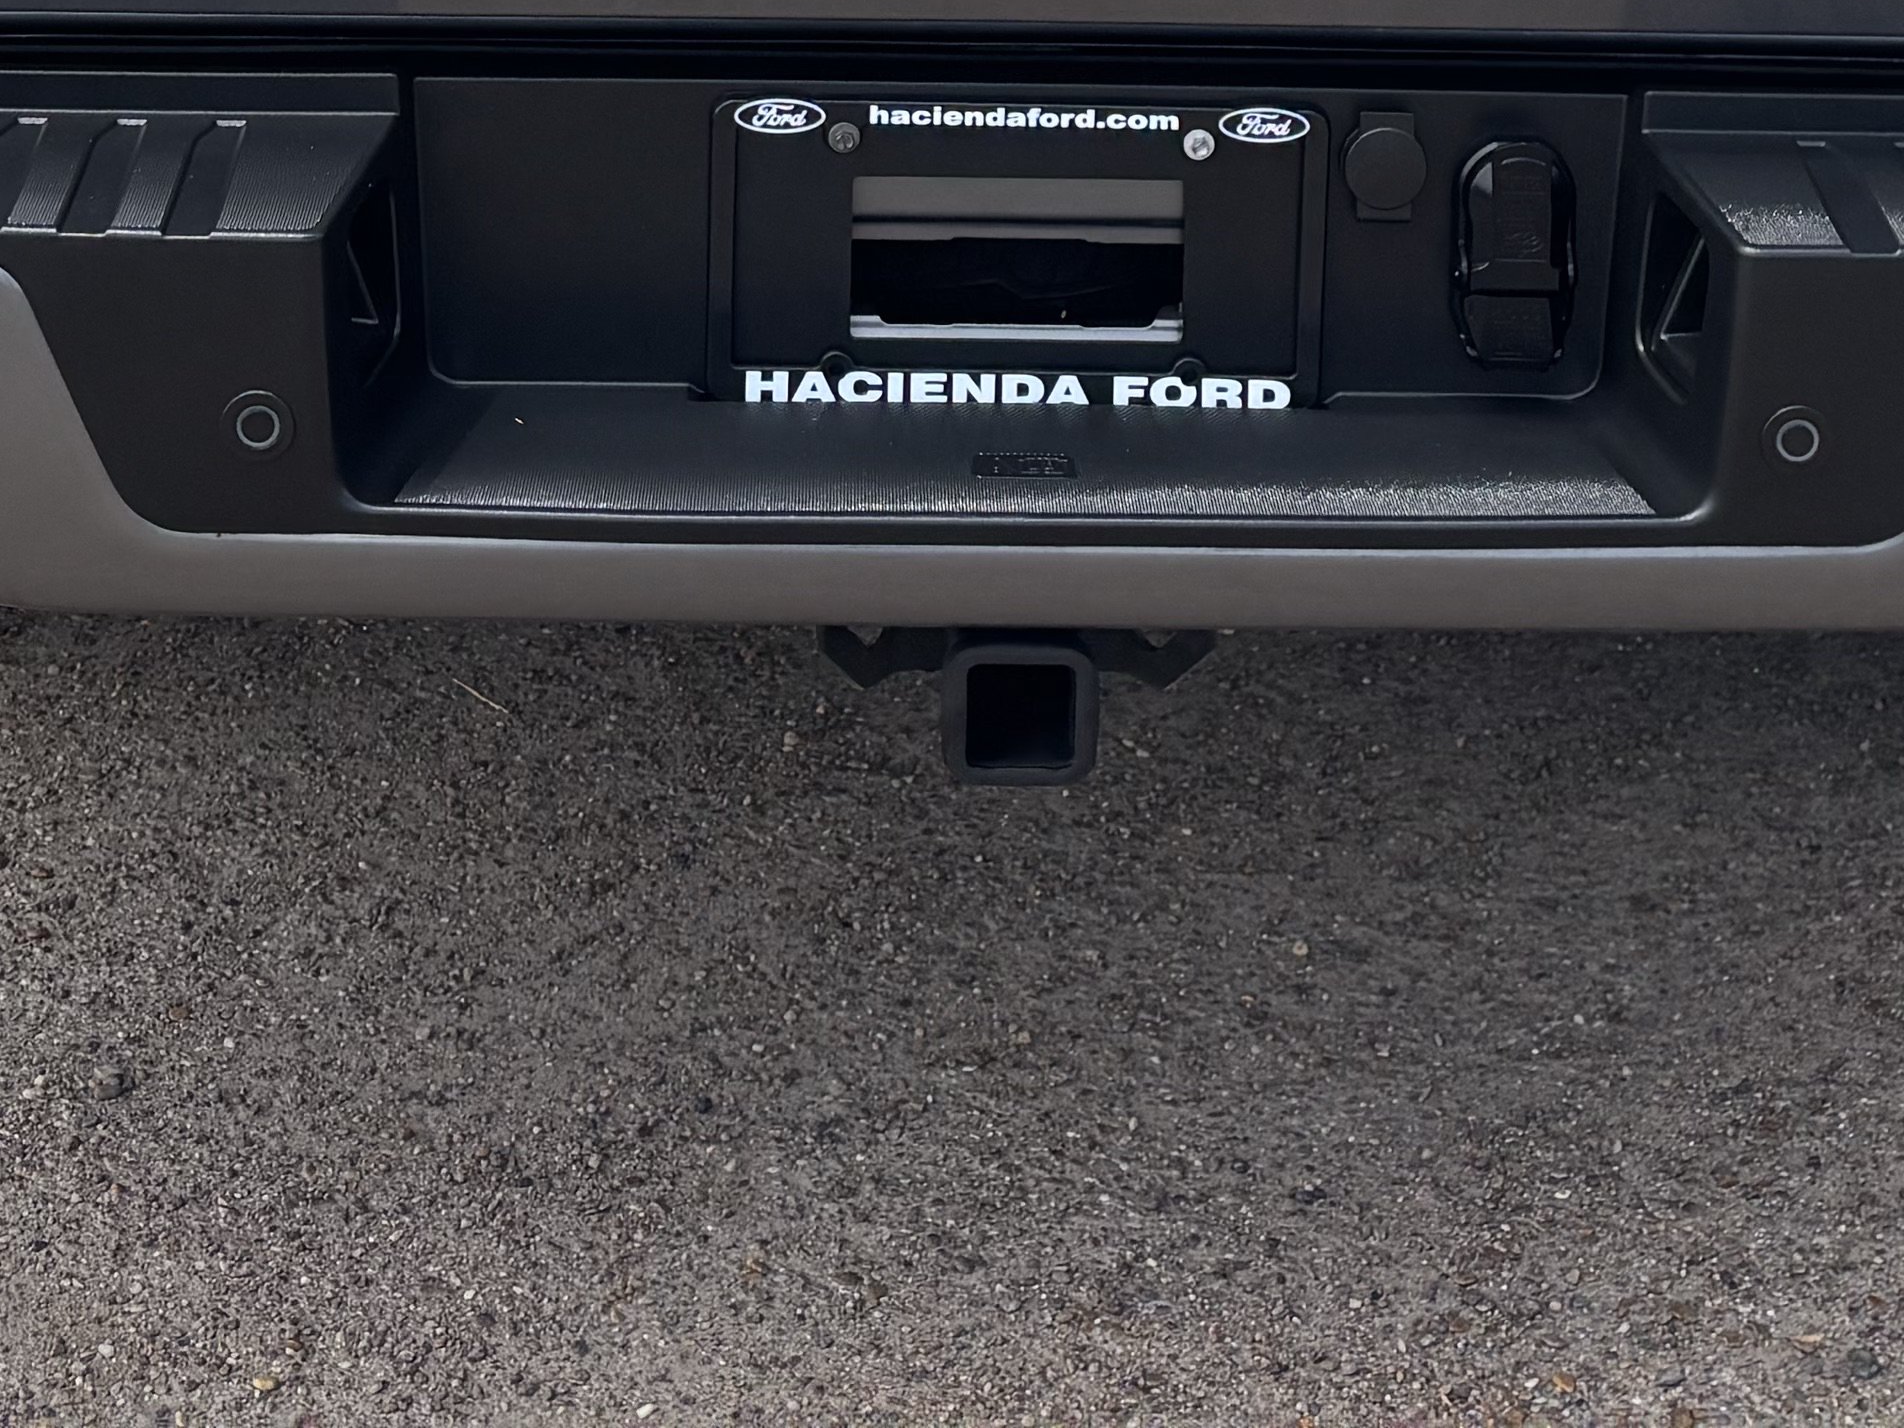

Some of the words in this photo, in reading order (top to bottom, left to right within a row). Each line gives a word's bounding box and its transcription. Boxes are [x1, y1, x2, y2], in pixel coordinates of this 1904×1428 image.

[751, 104, 808, 129] Ford
[868, 105, 1180, 132] haciendaford.com
[1234, 113, 1291, 138] Ford
[744, 370, 1089, 405] HACIENDA
[1112, 376, 1291, 411] FORD
